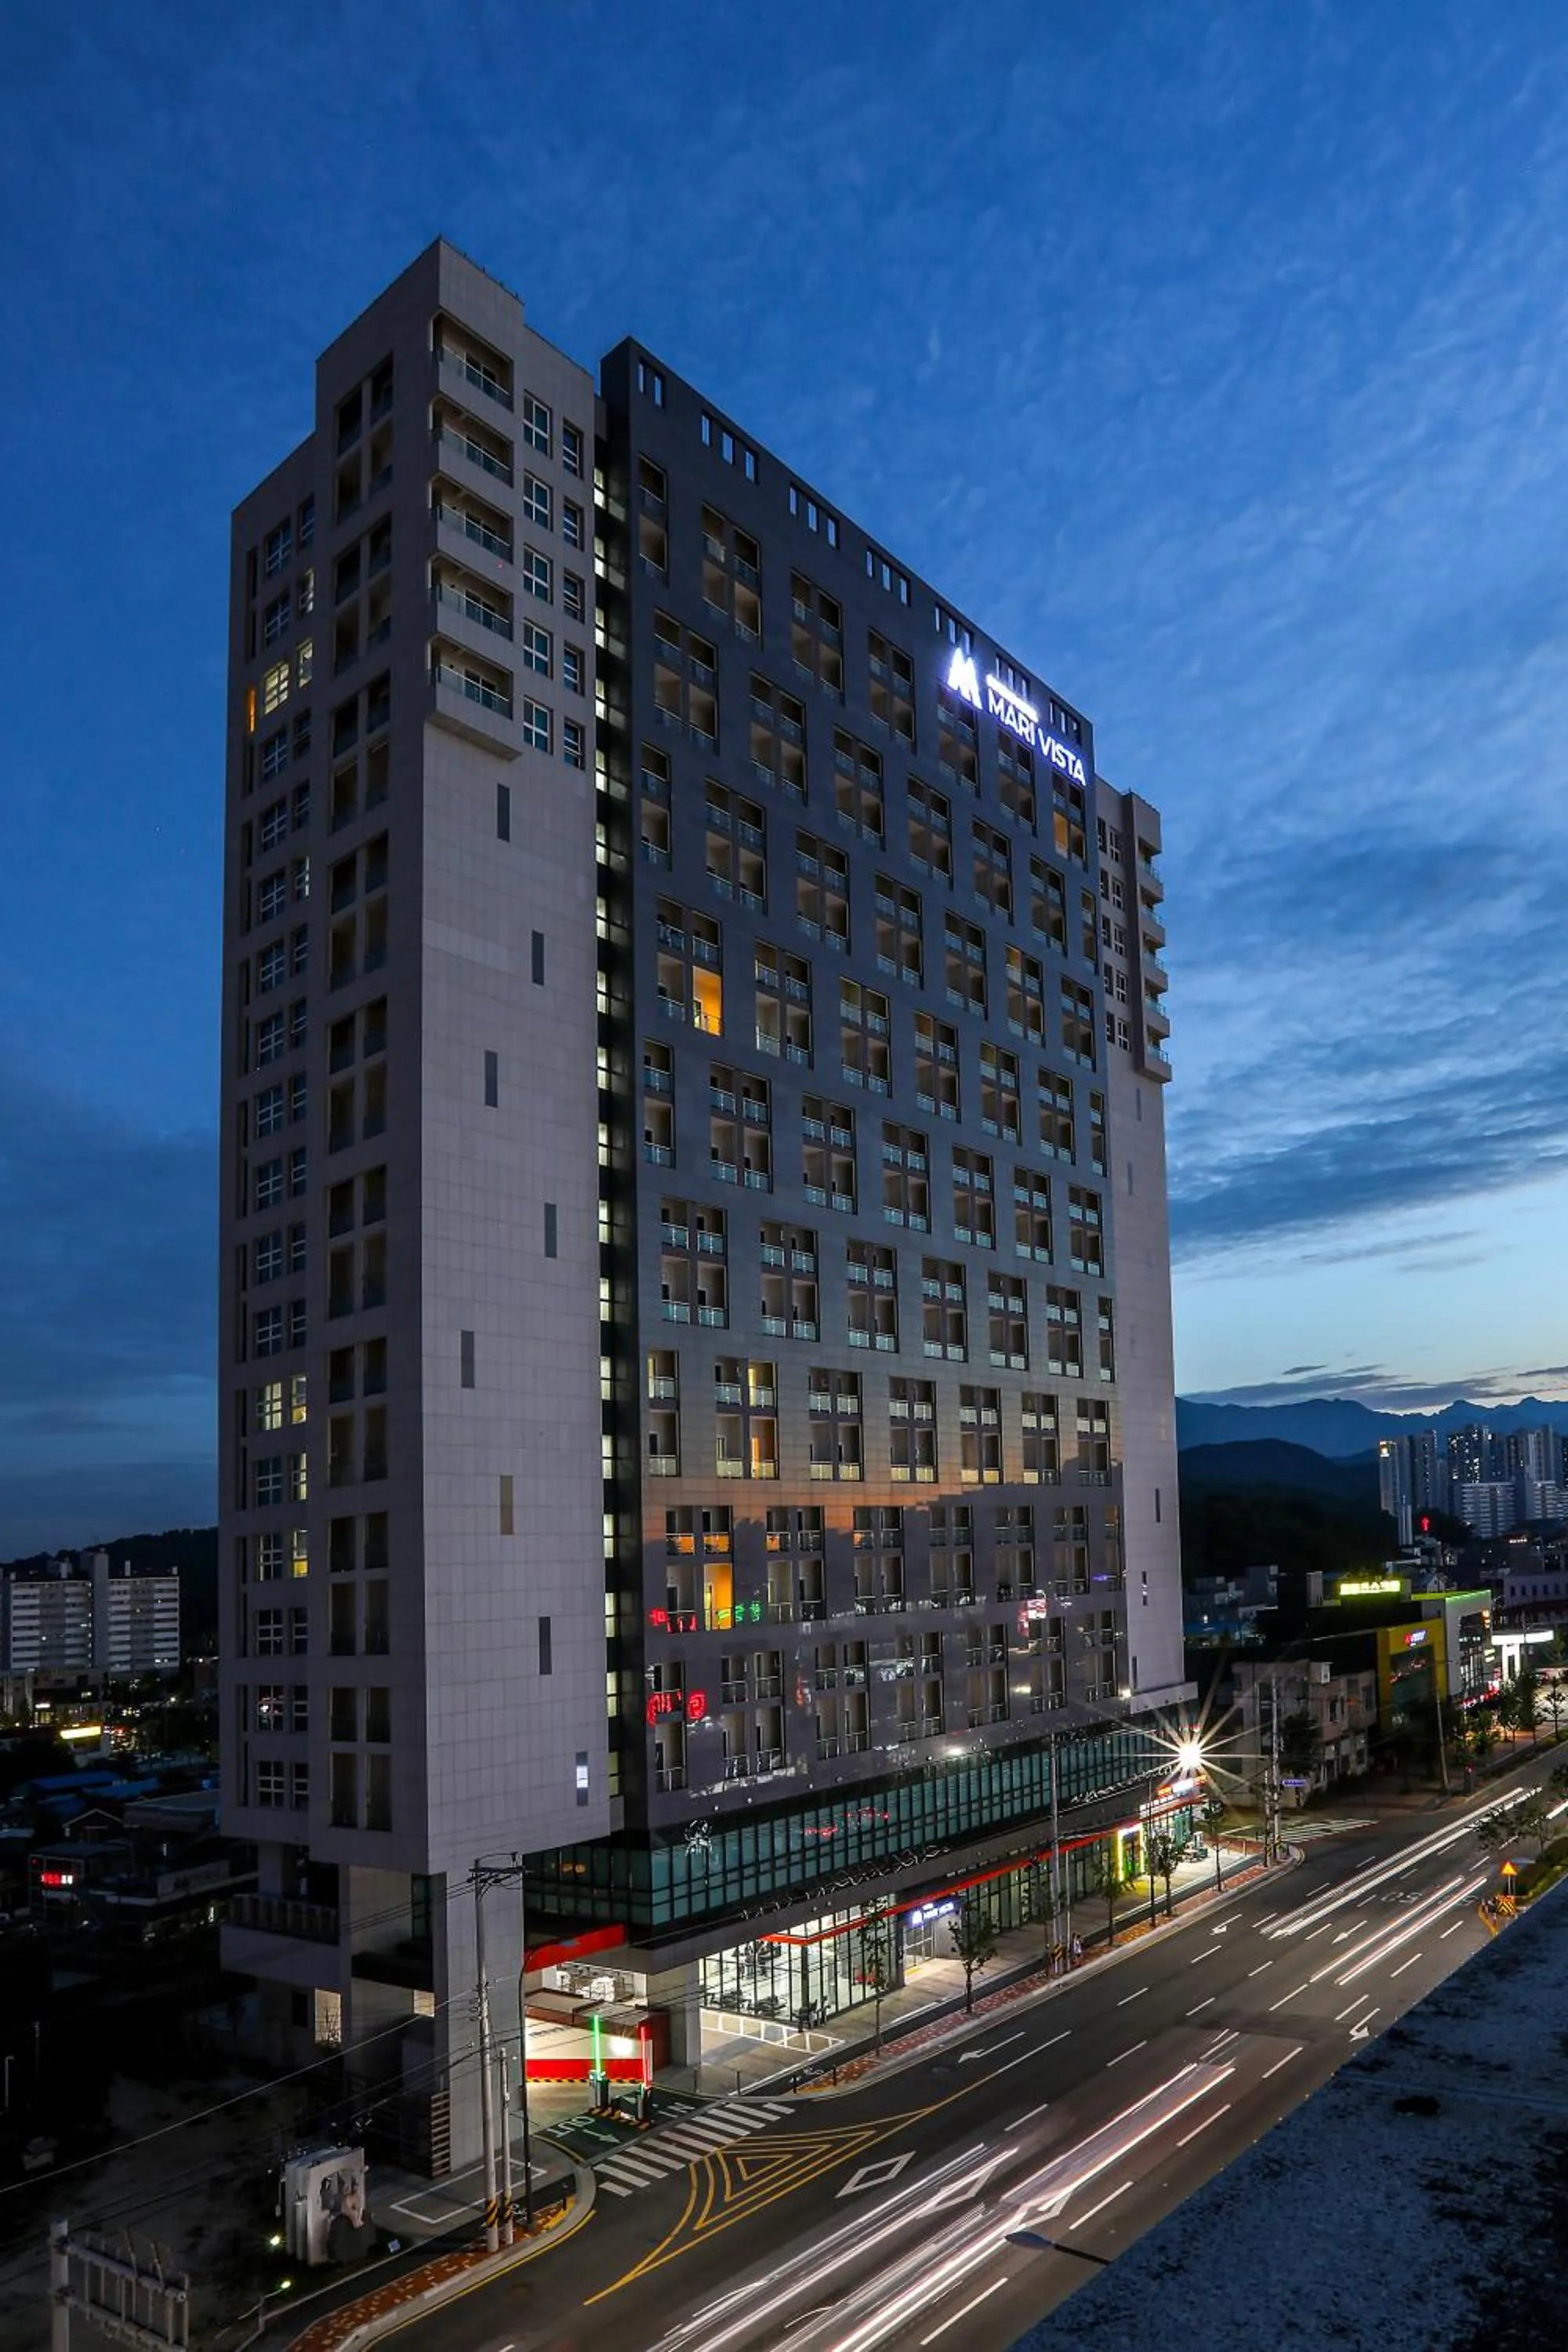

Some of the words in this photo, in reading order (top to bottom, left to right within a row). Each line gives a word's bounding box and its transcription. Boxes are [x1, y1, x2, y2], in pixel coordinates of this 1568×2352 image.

[989, 688, 1035, 746] MARI
[1037, 728, 1086, 786] VISTA
[546, 2116, 596, 2138] OUT
